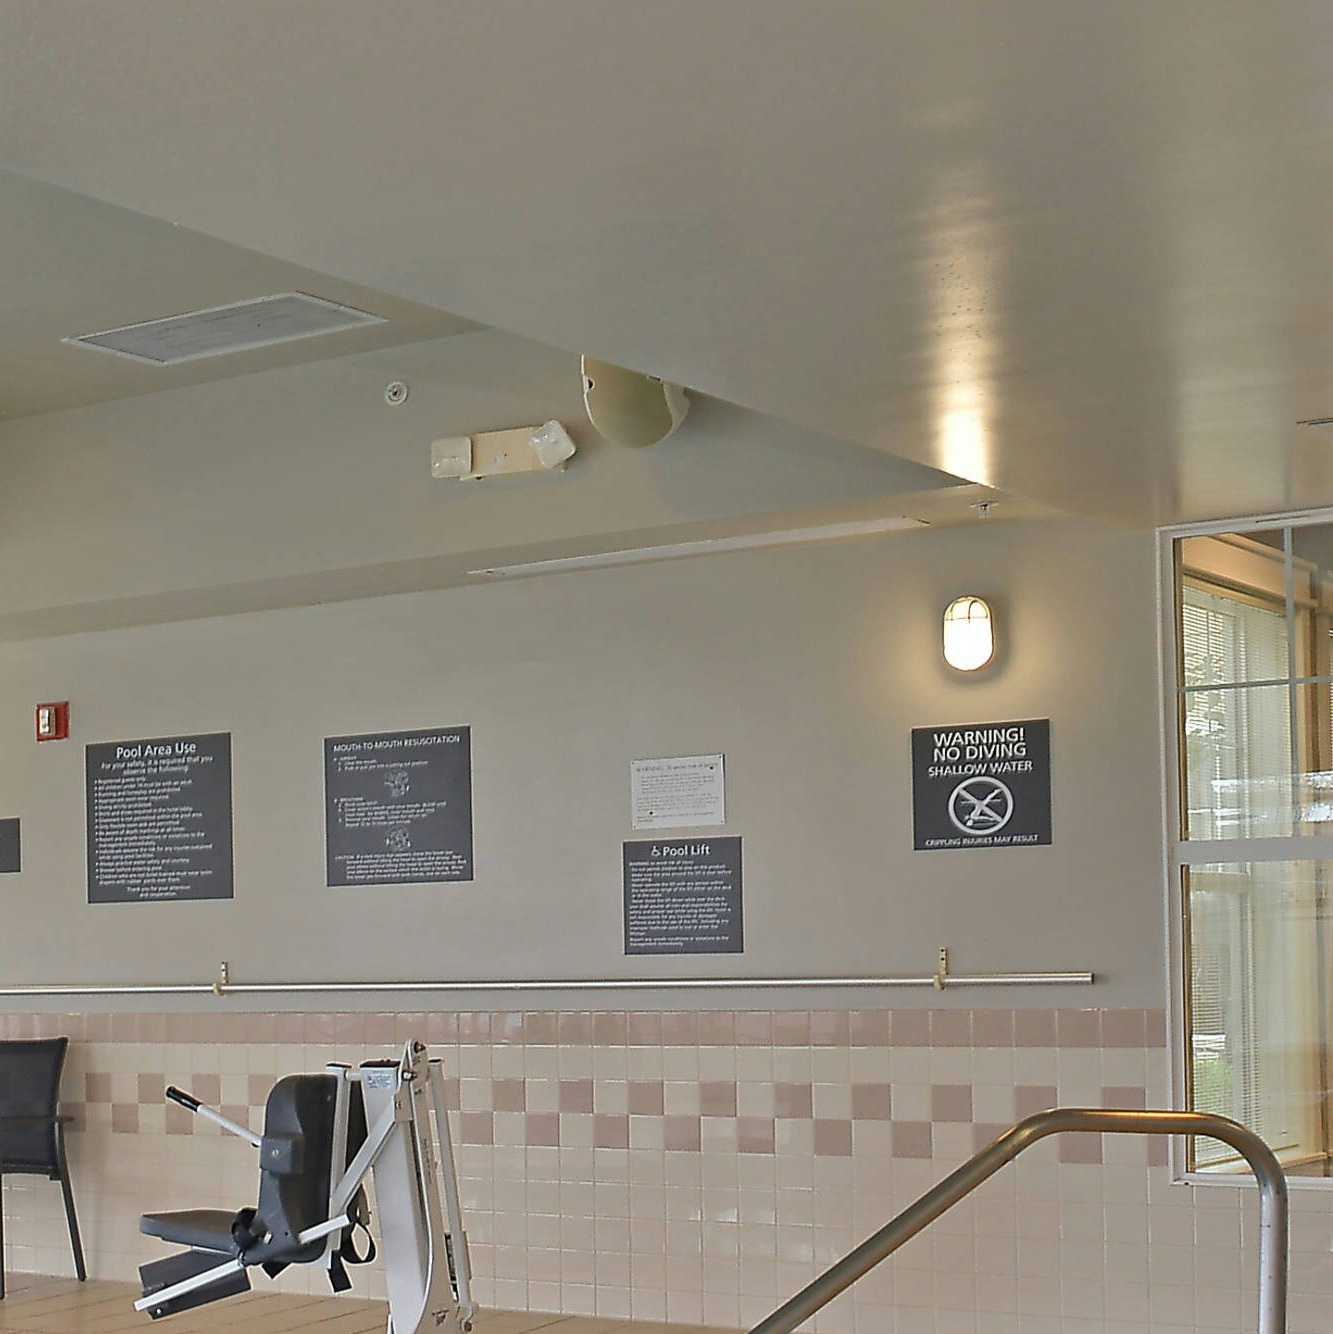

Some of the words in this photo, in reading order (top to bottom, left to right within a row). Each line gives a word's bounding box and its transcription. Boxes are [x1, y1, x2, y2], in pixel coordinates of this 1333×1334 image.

[404, 735, 461, 747] RESUSCITATION
[933, 727, 1025, 747] WARNING!
[116, 745, 142, 759] Pool
[144, 744, 172, 757] Area
[175, 742, 197, 754] Use
[934, 747, 960, 762] NO
[965, 742, 1026, 760] DIVING
[928, 763, 987, 777] SHALLOW
[990, 760, 1033, 774] WATER
[993, 835, 1011, 843] MAY
[1012, 834, 1038, 842] RESULT
[662, 844, 688, 857] Pool
[691, 843, 710, 856] Lift
